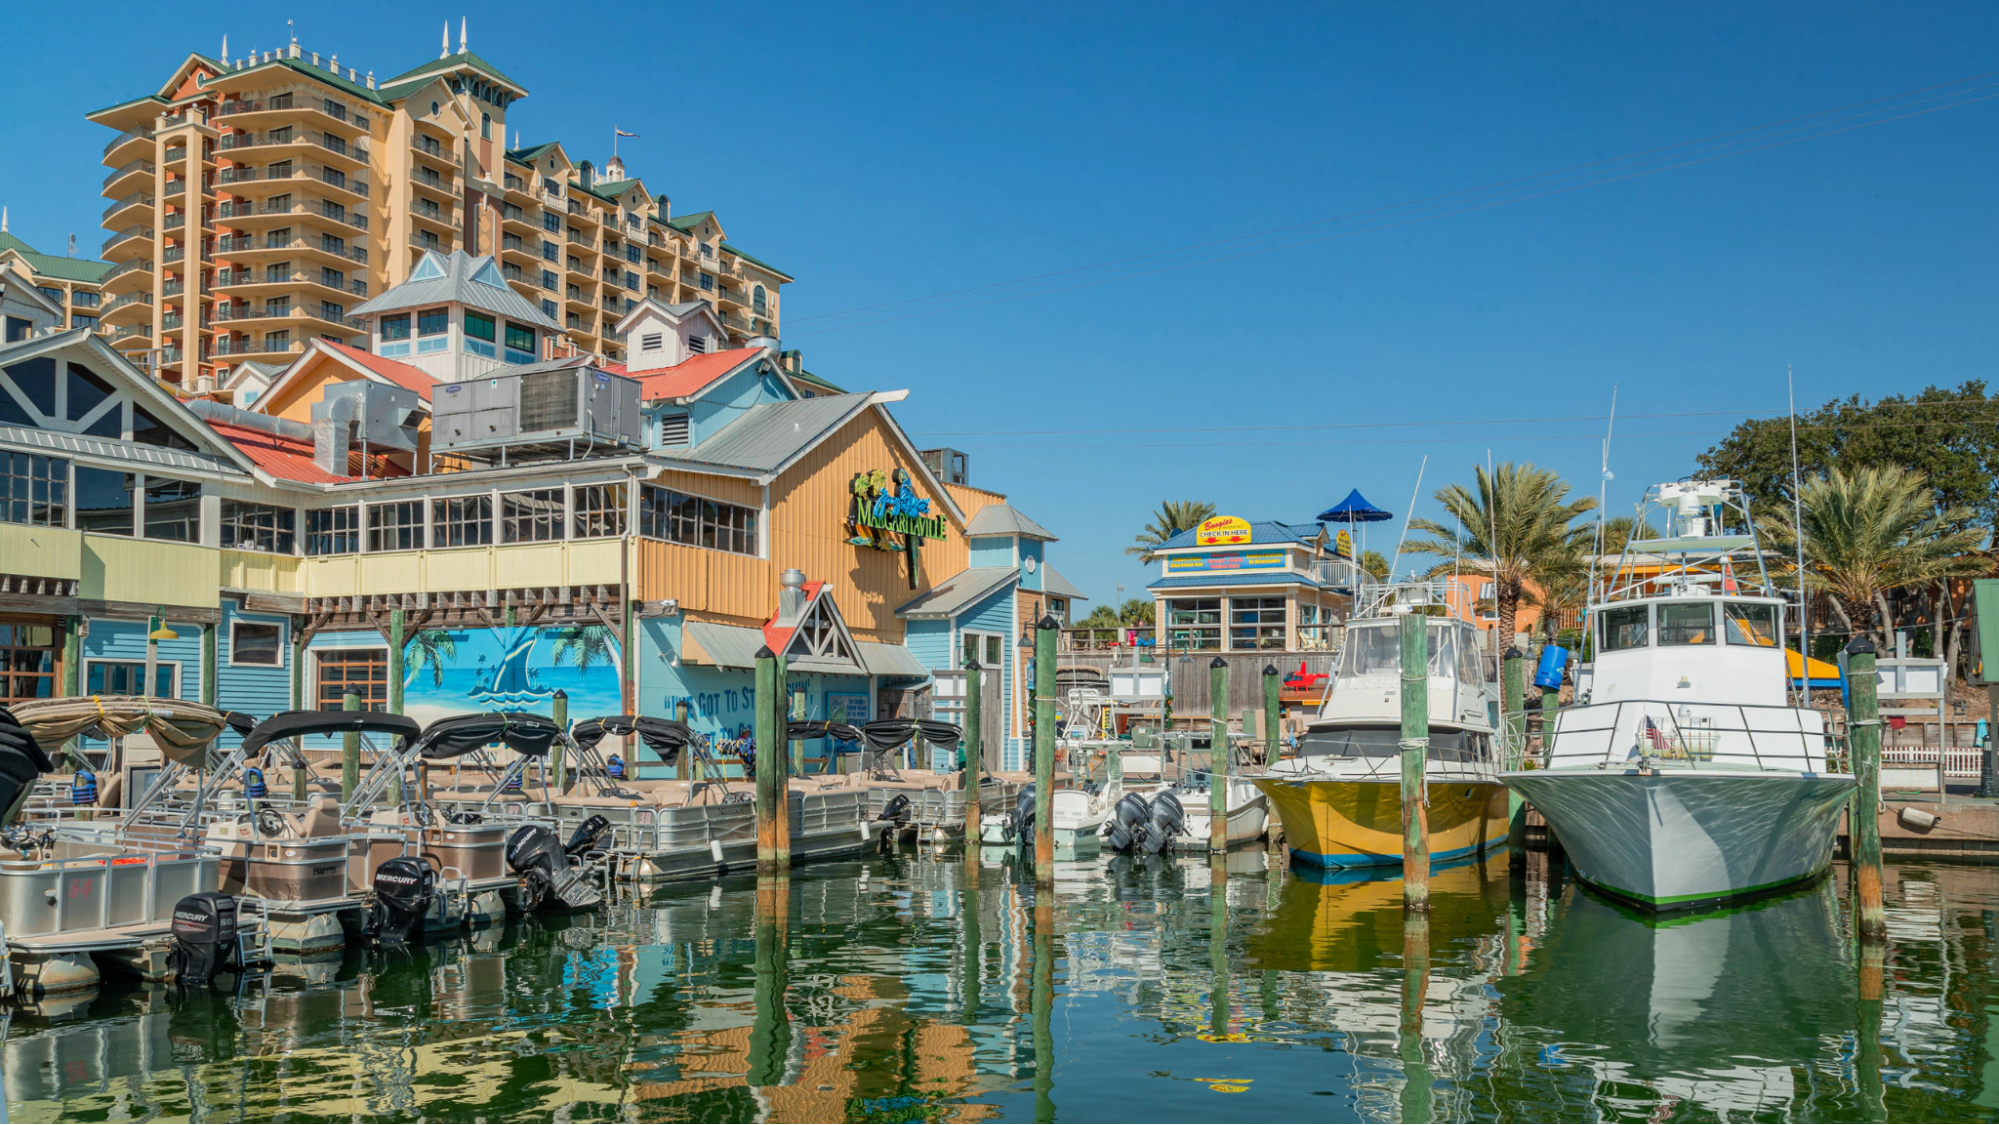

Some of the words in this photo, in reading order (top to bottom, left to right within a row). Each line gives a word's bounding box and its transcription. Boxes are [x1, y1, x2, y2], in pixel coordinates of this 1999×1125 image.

[1204, 518, 1233, 531] Boogies
[1199, 530, 1222, 538] CHECK
[700, 691, 721, 718] GOT
[724, 688, 738, 713] TO
[741, 686, 756, 710] ST
[375, 873, 418, 885] MERCURY
[69, 877, 93, 900] 64
[174, 910, 209, 922] MERCURY
[220, 917, 233, 926] 50
